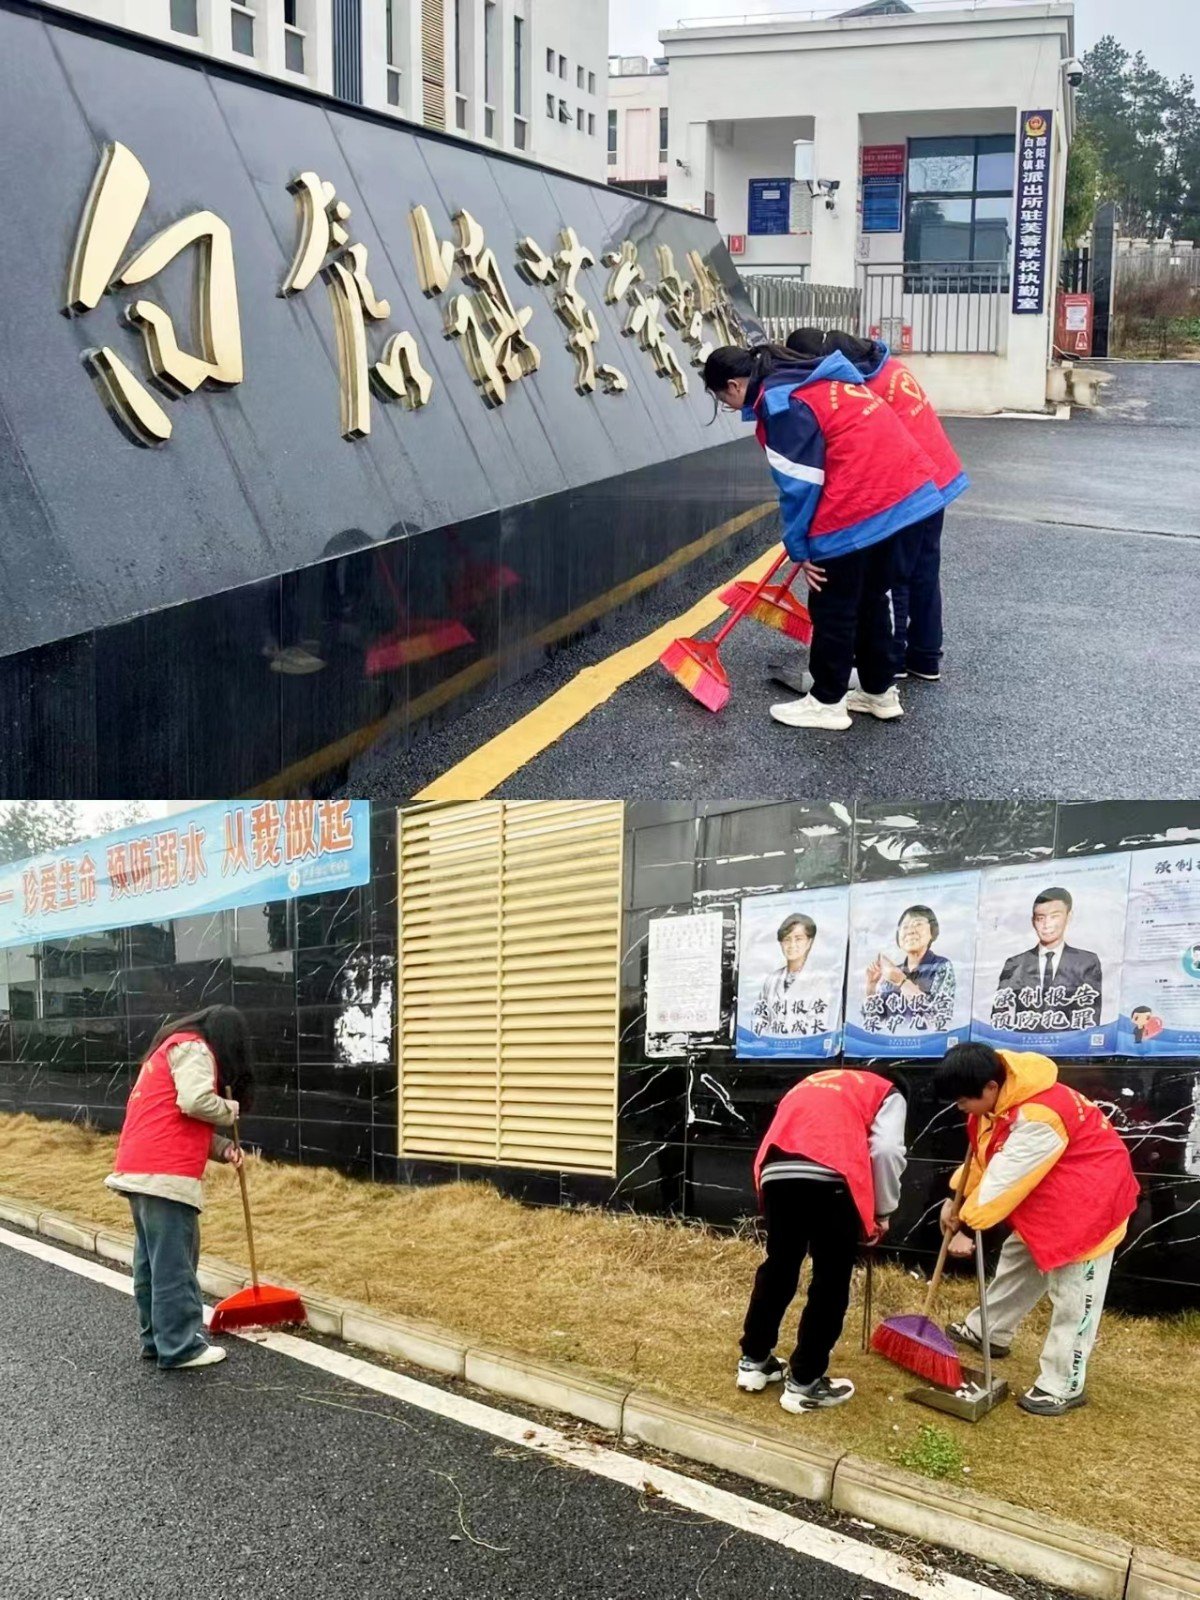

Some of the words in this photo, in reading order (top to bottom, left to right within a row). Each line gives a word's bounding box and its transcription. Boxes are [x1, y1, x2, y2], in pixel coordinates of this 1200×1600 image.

[1022, 138, 1034, 170] 白仓镇
[1035, 137, 1047, 170] 邵阳县
[1017, 171, 1044, 309] 派出所驻芙蓉学校执勤室
[22, 853, 97, 918] 珍爱生命
[106, 821, 207, 901] 预防溺水
[222, 800, 354, 877] 从我做起
[753, 998, 829, 1018] 强制报告
[864, 992, 951, 1014] 强制报告
[994, 984, 1099, 1008] 强制报告
[753, 1018, 828, 1037] 护航成长
[863, 1013, 951, 1035] 保护儿童
[992, 1008, 1097, 1032] 预防犯罪
